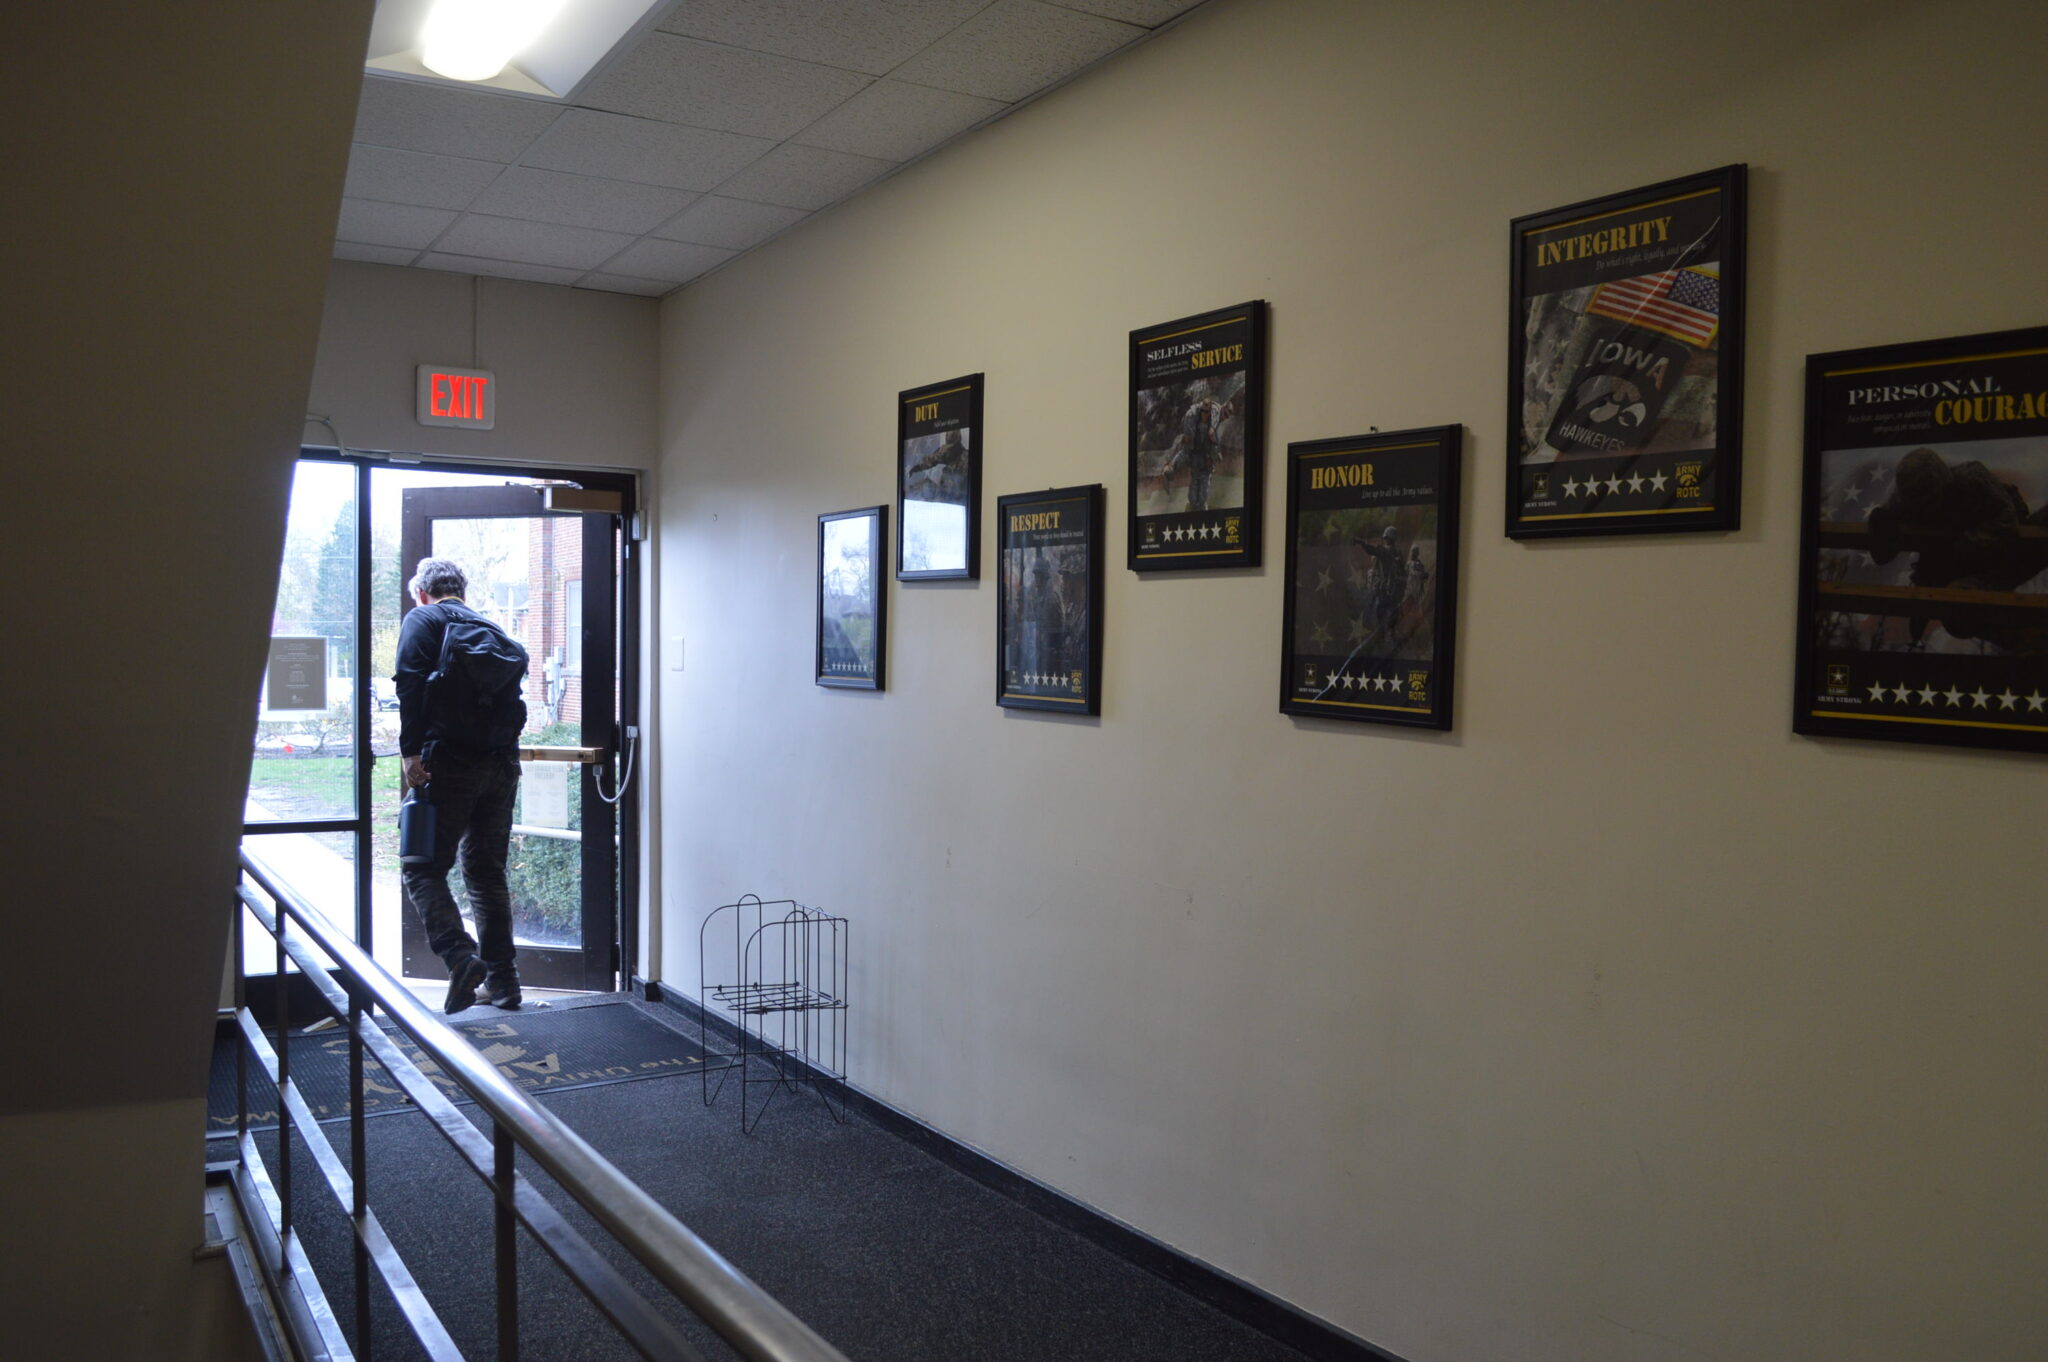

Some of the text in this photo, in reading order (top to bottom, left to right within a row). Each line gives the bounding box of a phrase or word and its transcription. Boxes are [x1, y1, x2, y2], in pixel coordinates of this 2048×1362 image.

[1536, 216, 1672, 267] INTEGRITY
[1147, 341, 1202, 362] SELFLESS
[1191, 344, 1243, 370] SERVICE
[1585, 339, 1669, 392] IOWA
[431, 373, 488, 420] EXIT
[1848, 376, 2001, 405] PERSONAL
[915, 402, 940, 423] DUTY
[1559, 422, 1625, 451] HAWKEYES
[1311, 464, 1375, 489] HONOR
[1675, 464, 1702, 480] ARMY
[1676, 486, 1701, 498] ROTC
[1011, 511, 1060, 532] RESPECT
[640, 1056, 705, 1069] The
